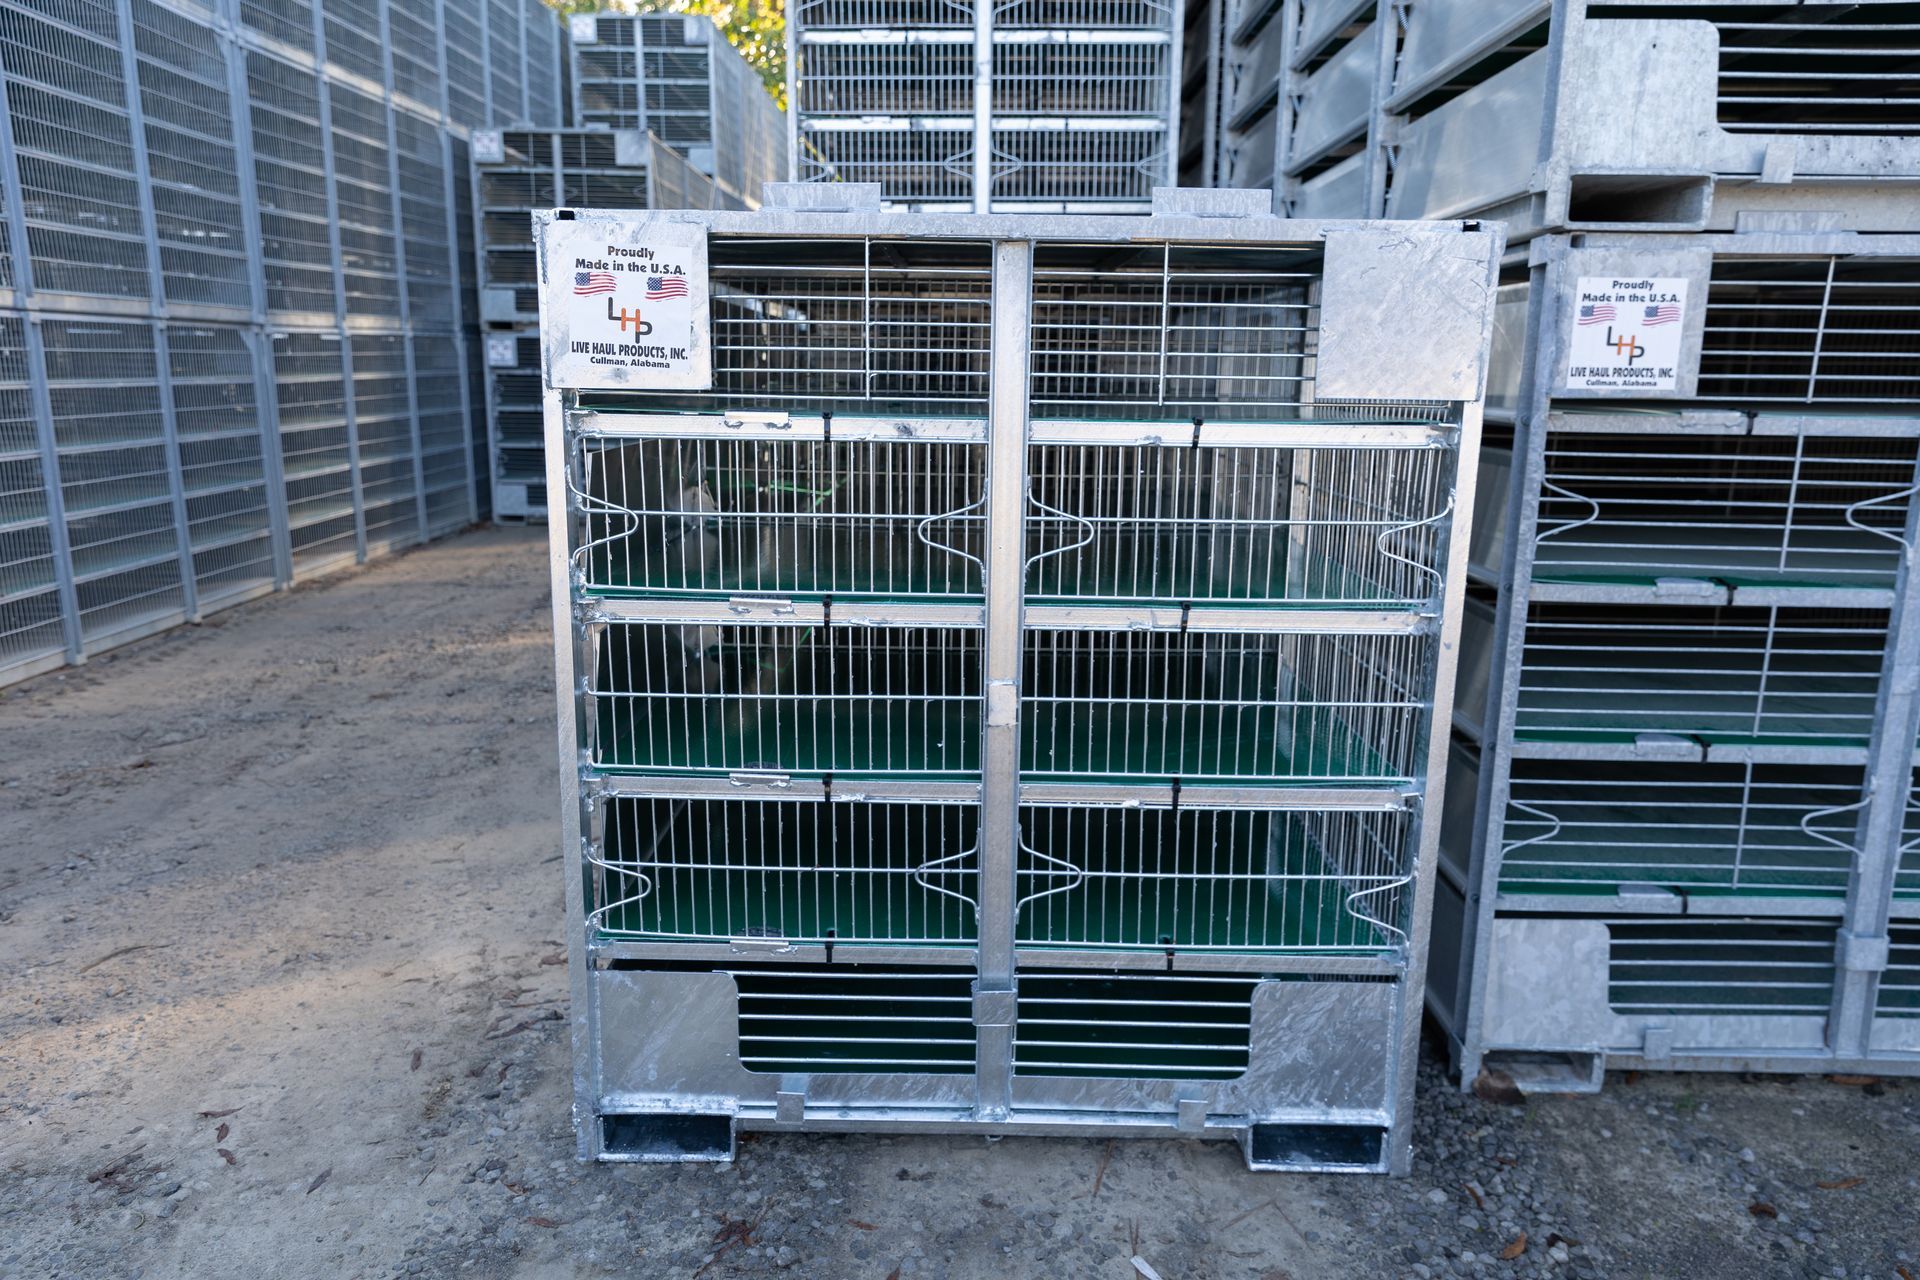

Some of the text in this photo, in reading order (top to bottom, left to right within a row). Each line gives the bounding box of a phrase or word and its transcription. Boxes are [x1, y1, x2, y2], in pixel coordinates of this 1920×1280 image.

[608, 246, 654, 260] Proudly
[576, 259, 686, 275] Made in the U.S.A.
[1612, 281, 1654, 291] Proudly
[1582, 293, 1680, 302] Made in the U.S.A.
[608, 297, 652, 344] LHP
[572, 341, 688, 360] LIVE HAUL PRODUCTS, INC.
[1607, 326, 1644, 366] LHP
[590, 357, 670, 368] Cullman, Alabama
[1571, 367, 1674, 379] LIVE HAUL PRODUCTS, INC.
